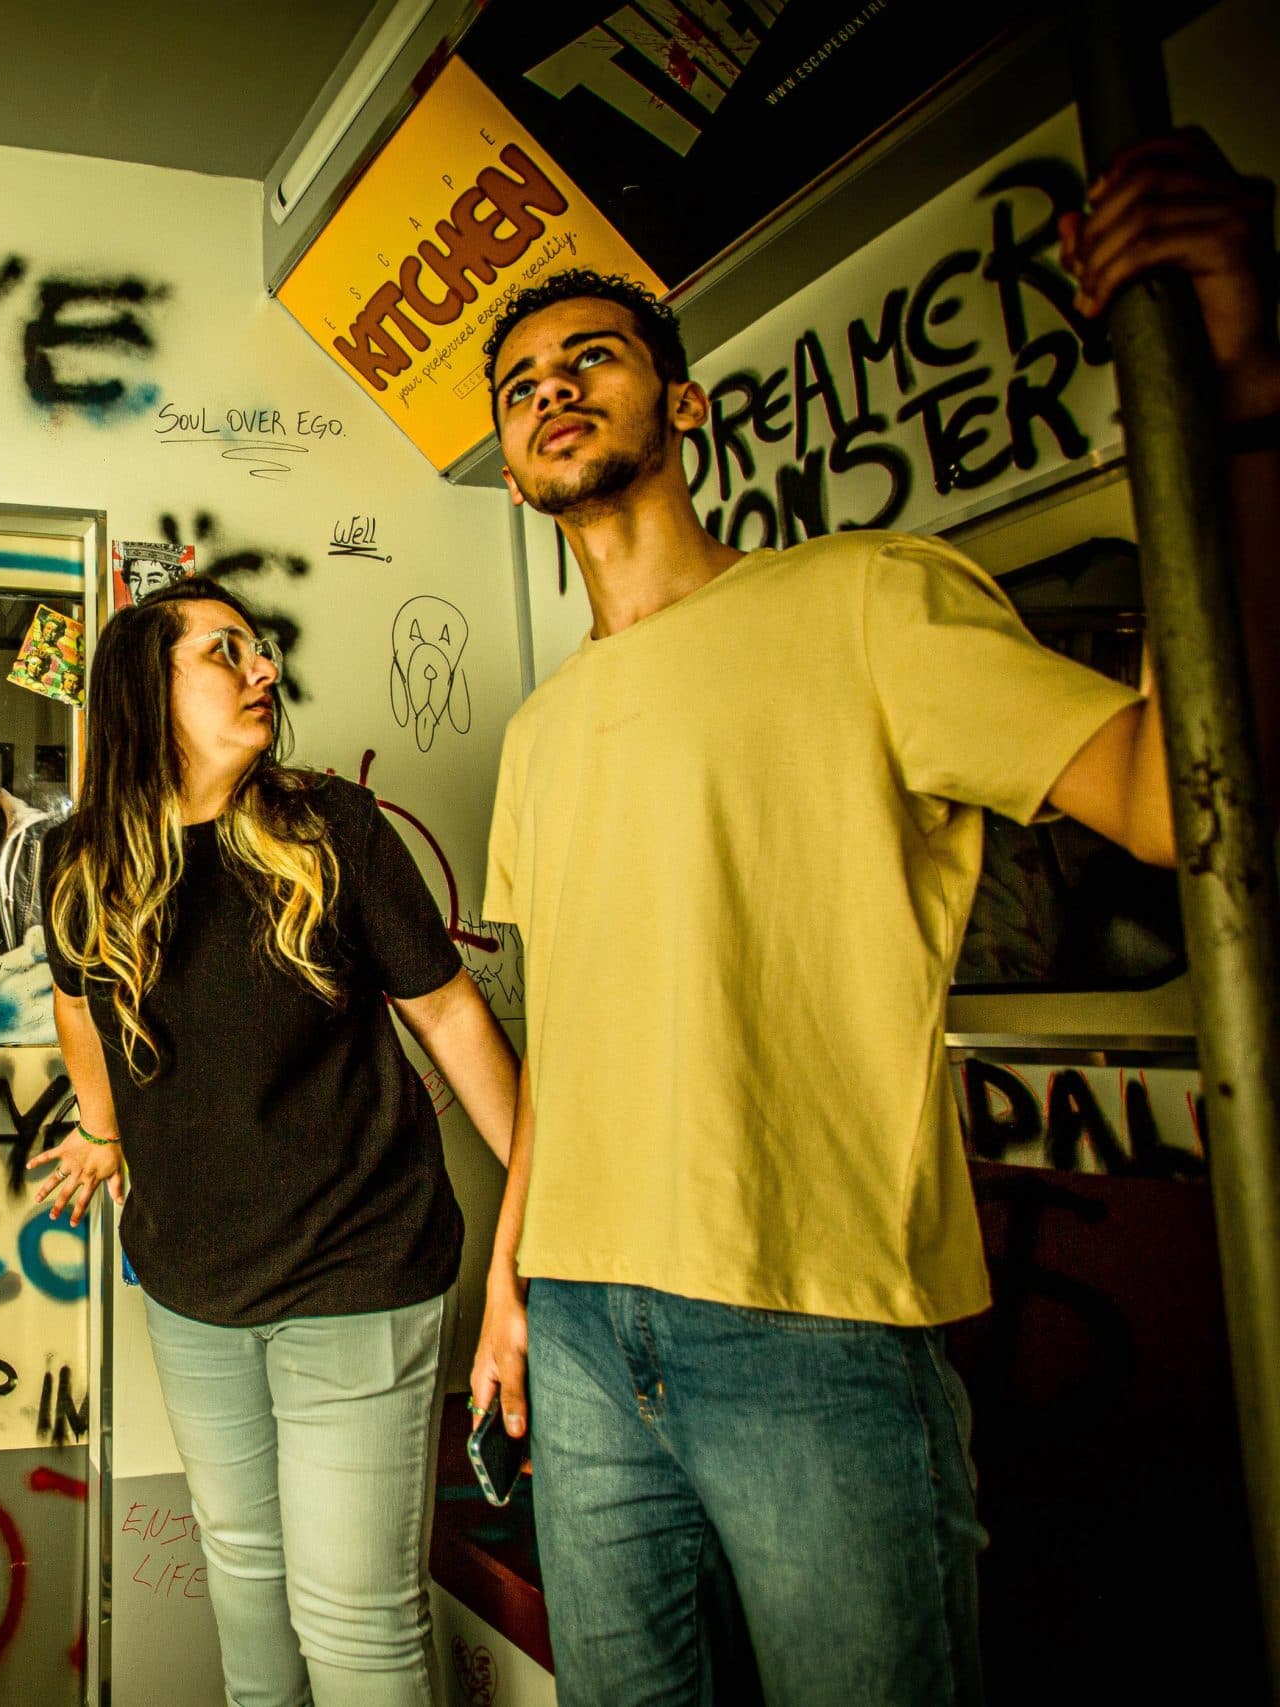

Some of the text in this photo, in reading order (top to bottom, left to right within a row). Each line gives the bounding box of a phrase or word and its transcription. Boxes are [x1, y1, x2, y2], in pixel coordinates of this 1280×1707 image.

[332, 142, 569, 392] KITCHEN
[226, 408, 287, 436] OVER
[421, 323, 477, 385] preferred
[707, 330, 1088, 548] ONSTER
